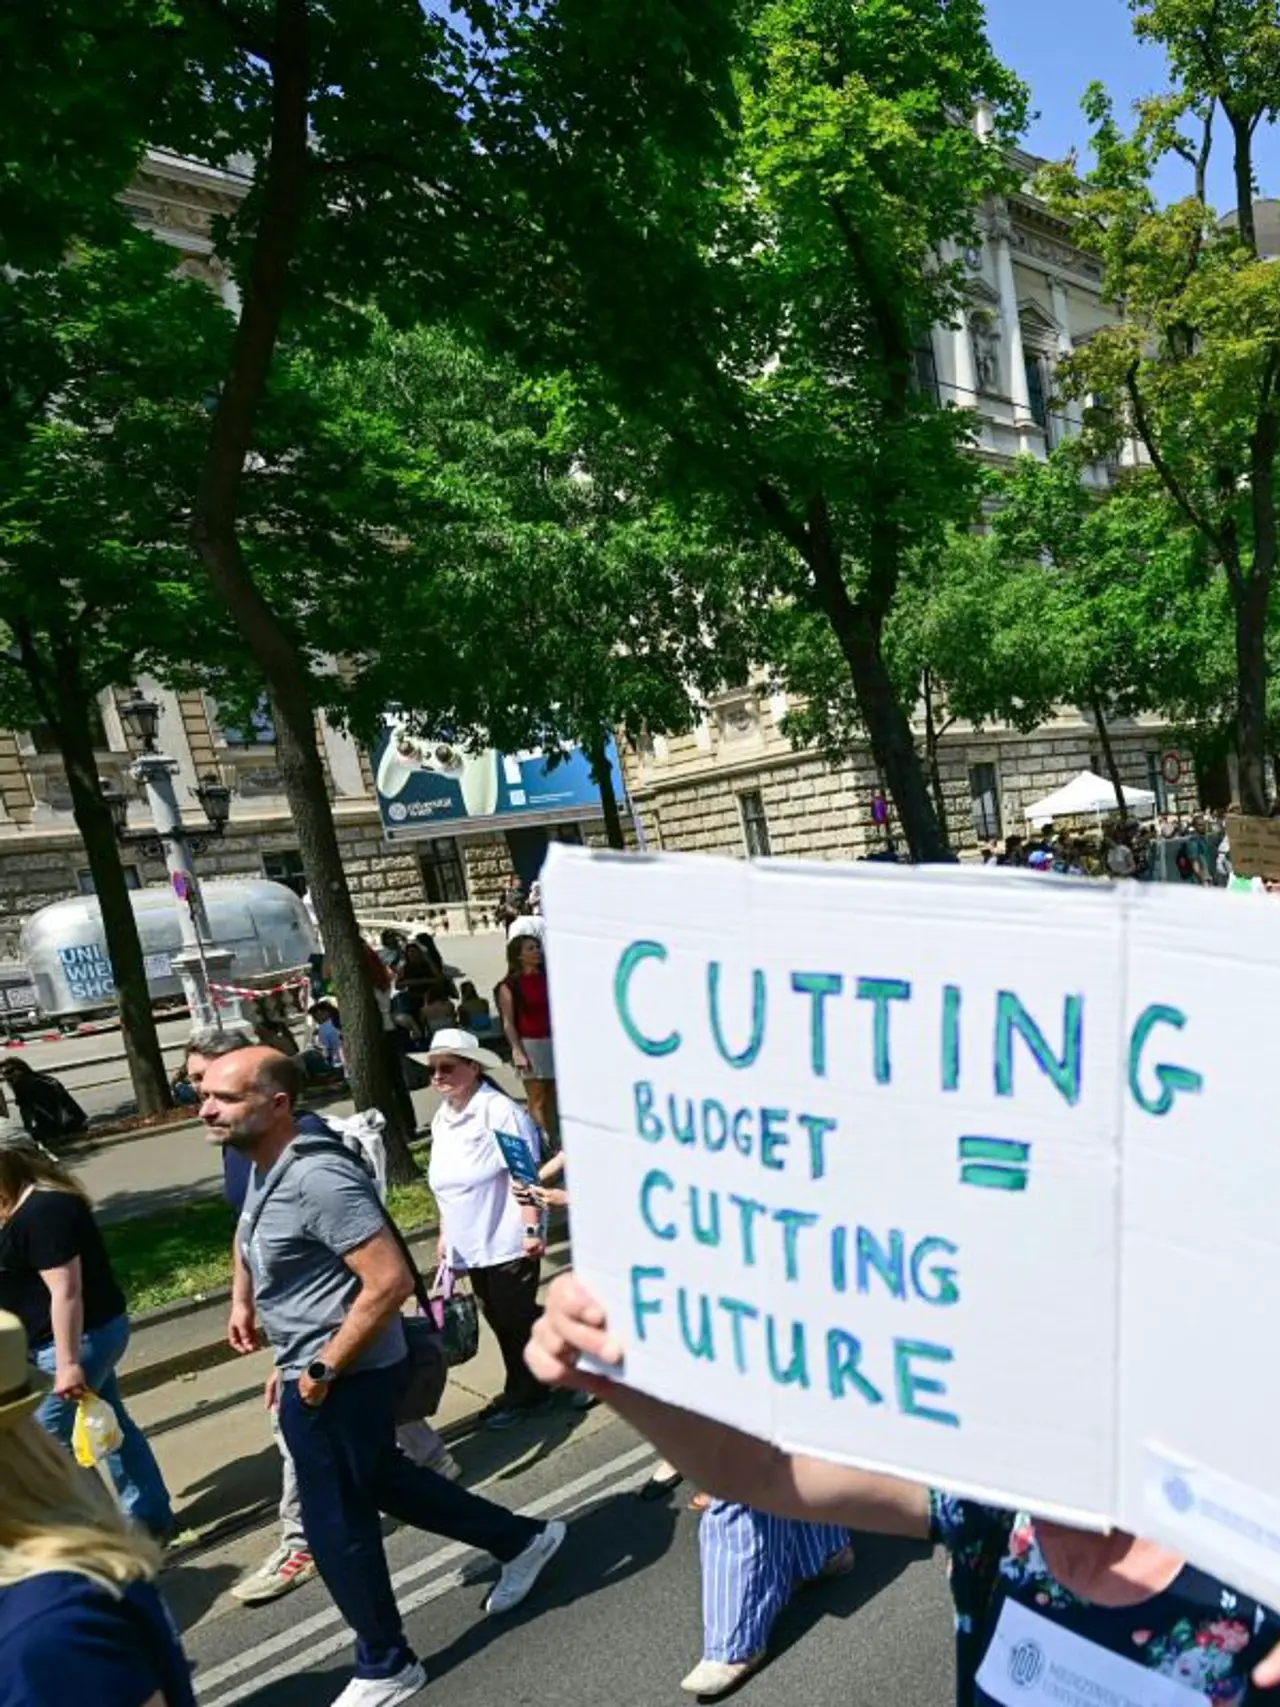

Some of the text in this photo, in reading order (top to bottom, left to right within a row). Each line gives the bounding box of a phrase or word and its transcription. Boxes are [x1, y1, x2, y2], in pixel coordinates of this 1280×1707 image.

[60, 945, 100, 964] UNI
[614, 940, 1203, 1116] CUTTING
[634, 1082, 836, 1180] BUDGET
[639, 1168, 960, 1307] CUTTING
[630, 1265, 960, 1427] FUTURE
